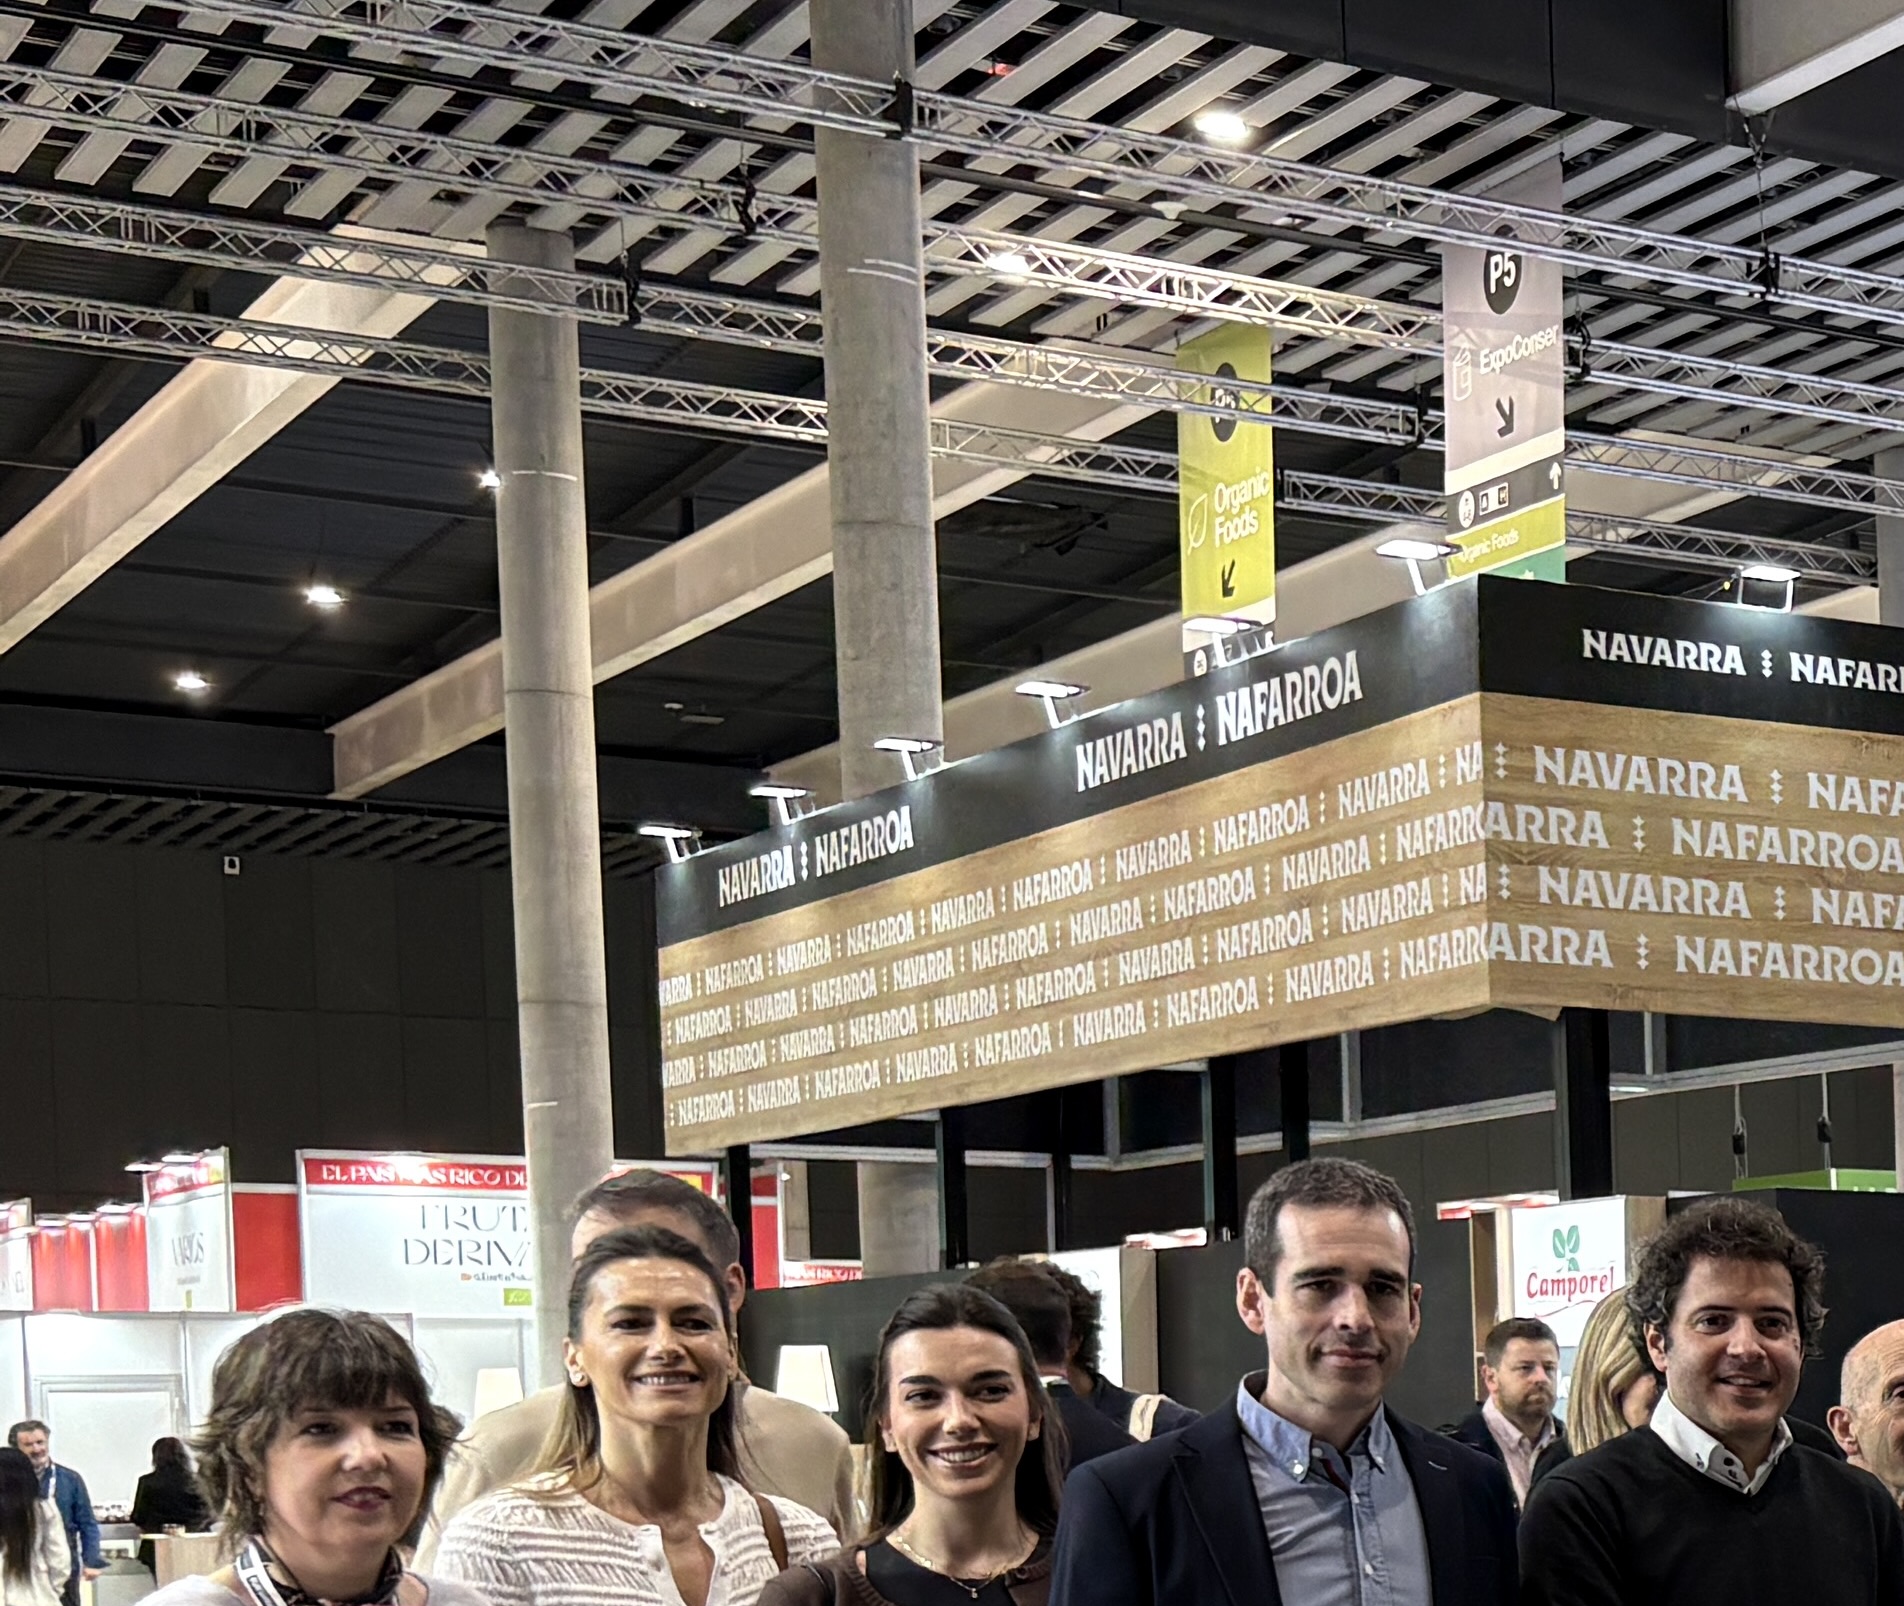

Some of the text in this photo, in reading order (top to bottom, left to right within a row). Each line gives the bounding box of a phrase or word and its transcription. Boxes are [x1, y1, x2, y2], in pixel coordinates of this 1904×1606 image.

[1489, 252, 1516, 294] P5
[1479, 324, 1559, 377] ExpoConser
[1214, 467, 1270, 516] Organic
[1214, 506, 1259, 548] Foods
[1492, 528, 1519, 551] Foods
[1582, 628, 1747, 676] NAVARRA
[1076, 651, 1363, 793] NAVARRA NAFARROA
[1534, 745, 1748, 802] NAVARRA
[1484, 801, 1609, 849] ARRA
[704, 953, 764, 995] NAFARROA
[775, 933, 831, 976] NAVARRA
[846, 909, 915, 957] NAFARROA
[930, 887, 995, 935] NAVARRA
[1012, 857, 1093, 911] NAFARROA
[1115, 829, 1192, 882] NAVARRA
[1212, 794, 1309, 855] NAFARROA
[1338, 757, 1430, 819] NAVARRA
[718, 805, 915, 908] NAVARRA NAFARROA
[1537, 865, 1751, 918] NAVARRA
[674, 1004, 733, 1045] NAFARROA
[743, 987, 798, 1027] NAVARRA
[811, 966, 878, 1011] NAFARROA
[892, 946, 955, 991] NAVARRA
[970, 921, 1049, 972] NAFARROA
[1069, 896, 1143, 947] NAVARRA
[1163, 865, 1256, 922] NAFARROA
[1281, 834, 1371, 892] NAVARRA
[1487, 921, 1613, 968] ARRA
[707, 1039, 767, 1078] NAFARROA
[778, 1023, 835, 1062] NAVARRA
[848, 1003, 918, 1047] NAFARROA
[933, 983, 998, 1028] NAVARRA
[1014, 959, 1096, 1009] NAFARROA
[1117, 936, 1195, 986] NAVARRA
[1215, 907, 1313, 963] NAFARROA
[1340, 876, 1433, 933] NAVARRA
[677, 1088, 735, 1126] NAFARROA
[746, 1074, 801, 1113] NAVARRA
[813, 1058, 881, 1100] NAFARROA
[895, 1041, 958, 1083] NAVARRA
[973, 1021, 1052, 1067] NAFARROA
[1072, 999, 1146, 1047] NAVARRA
[1165, 975, 1259, 1028] NAFARROA
[1284, 949, 1374, 1003] NAVARRA
[449, 1168, 501, 1186] RICO
[421, 1204, 527, 1233] FRUT
[1526, 1265, 1615, 1303] Camporel
